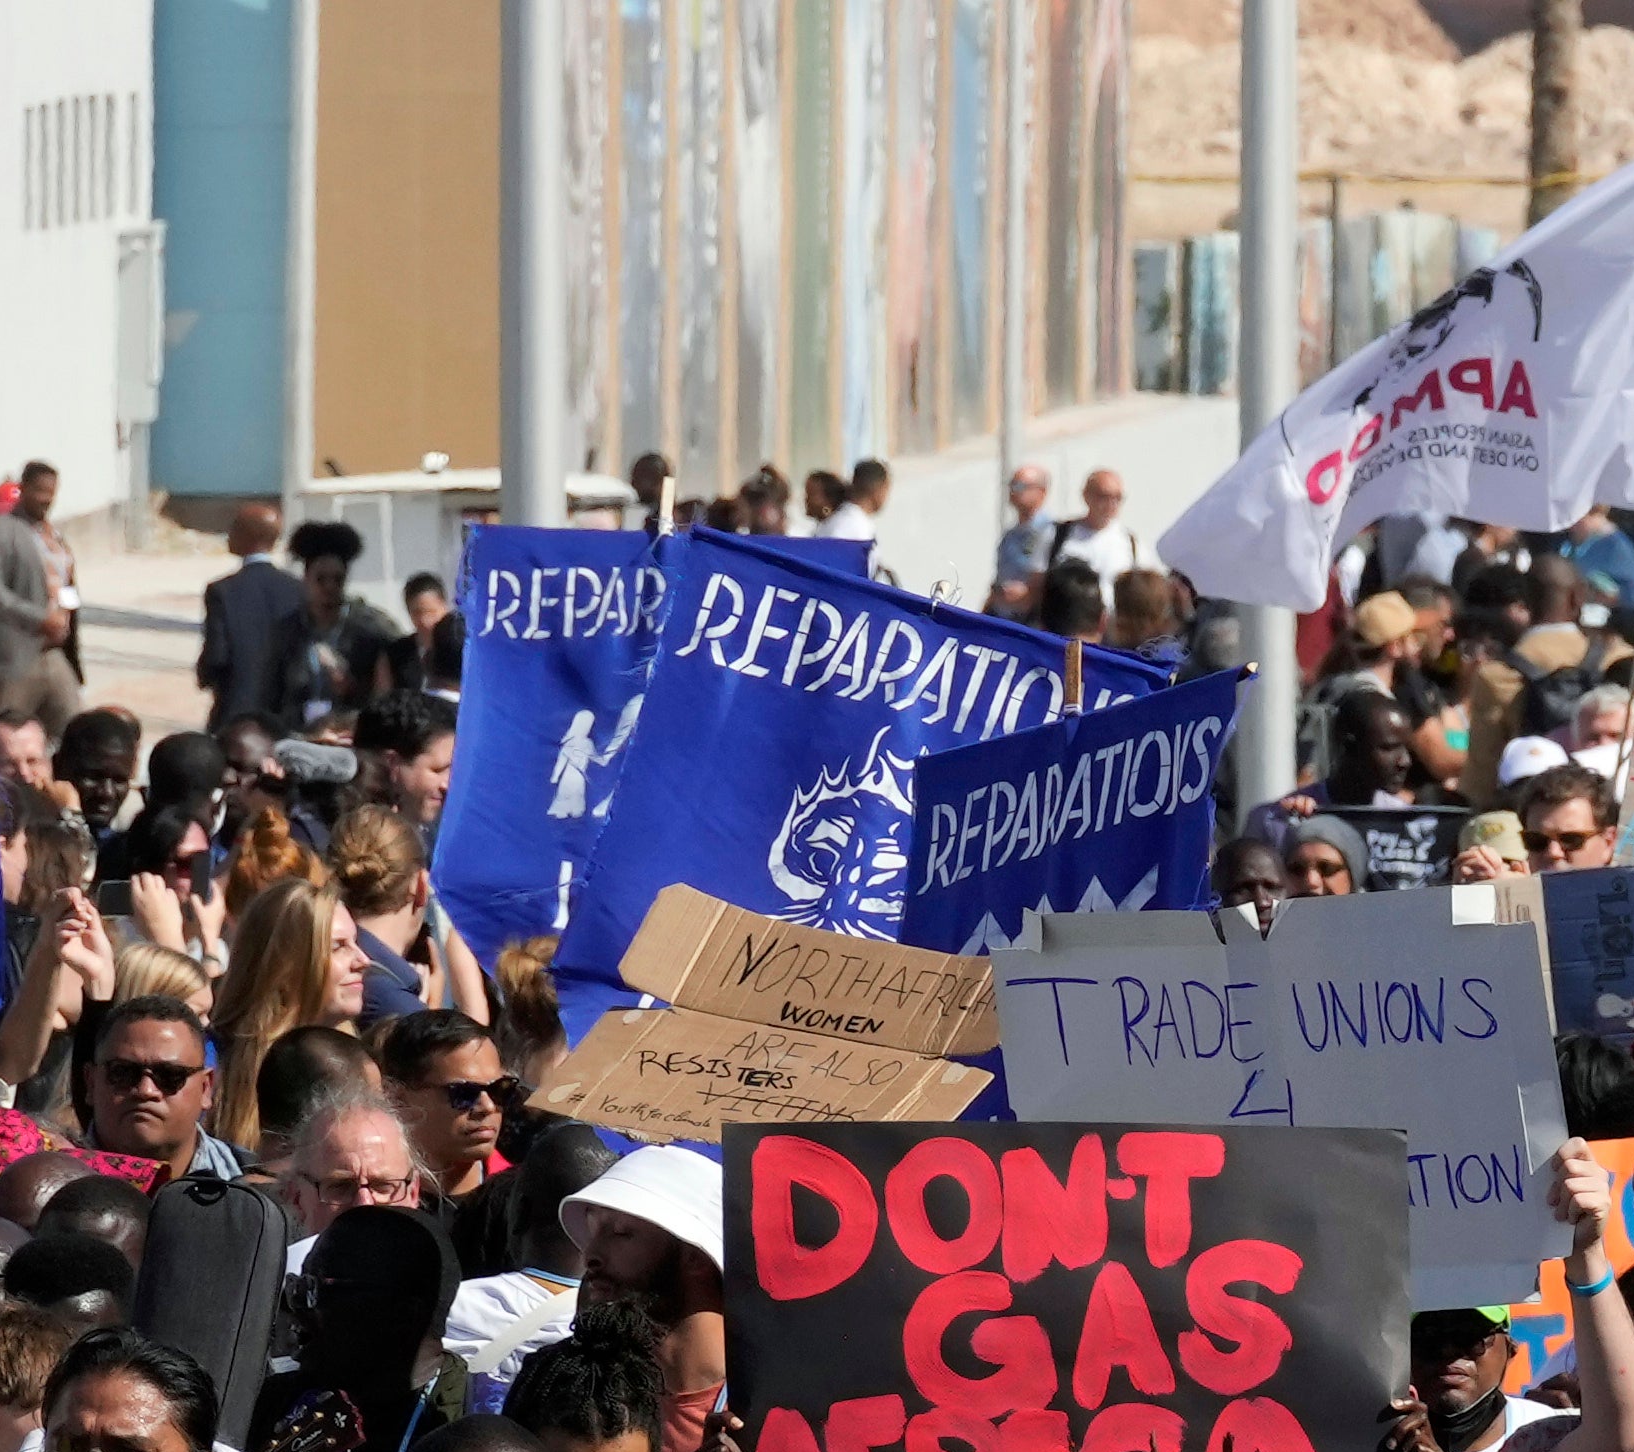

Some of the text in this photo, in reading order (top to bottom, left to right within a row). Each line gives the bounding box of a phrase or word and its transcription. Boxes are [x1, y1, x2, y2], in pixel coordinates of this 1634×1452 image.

[480, 566, 666, 640] REPAR
[676, 571, 1139, 742] REPARATIO
[917, 716, 1222, 894] REPARATIONS
[780, 1001, 884, 1034] WOMEN
[1008, 972, 1498, 1066] TRADE UNIONS
[634, 1049, 798, 1091] RESISTERS
[724, 1030, 904, 1087] ARE ALSO
[1407, 1143, 1525, 1211] TION
[903, 1239, 1305, 1408] GAS
